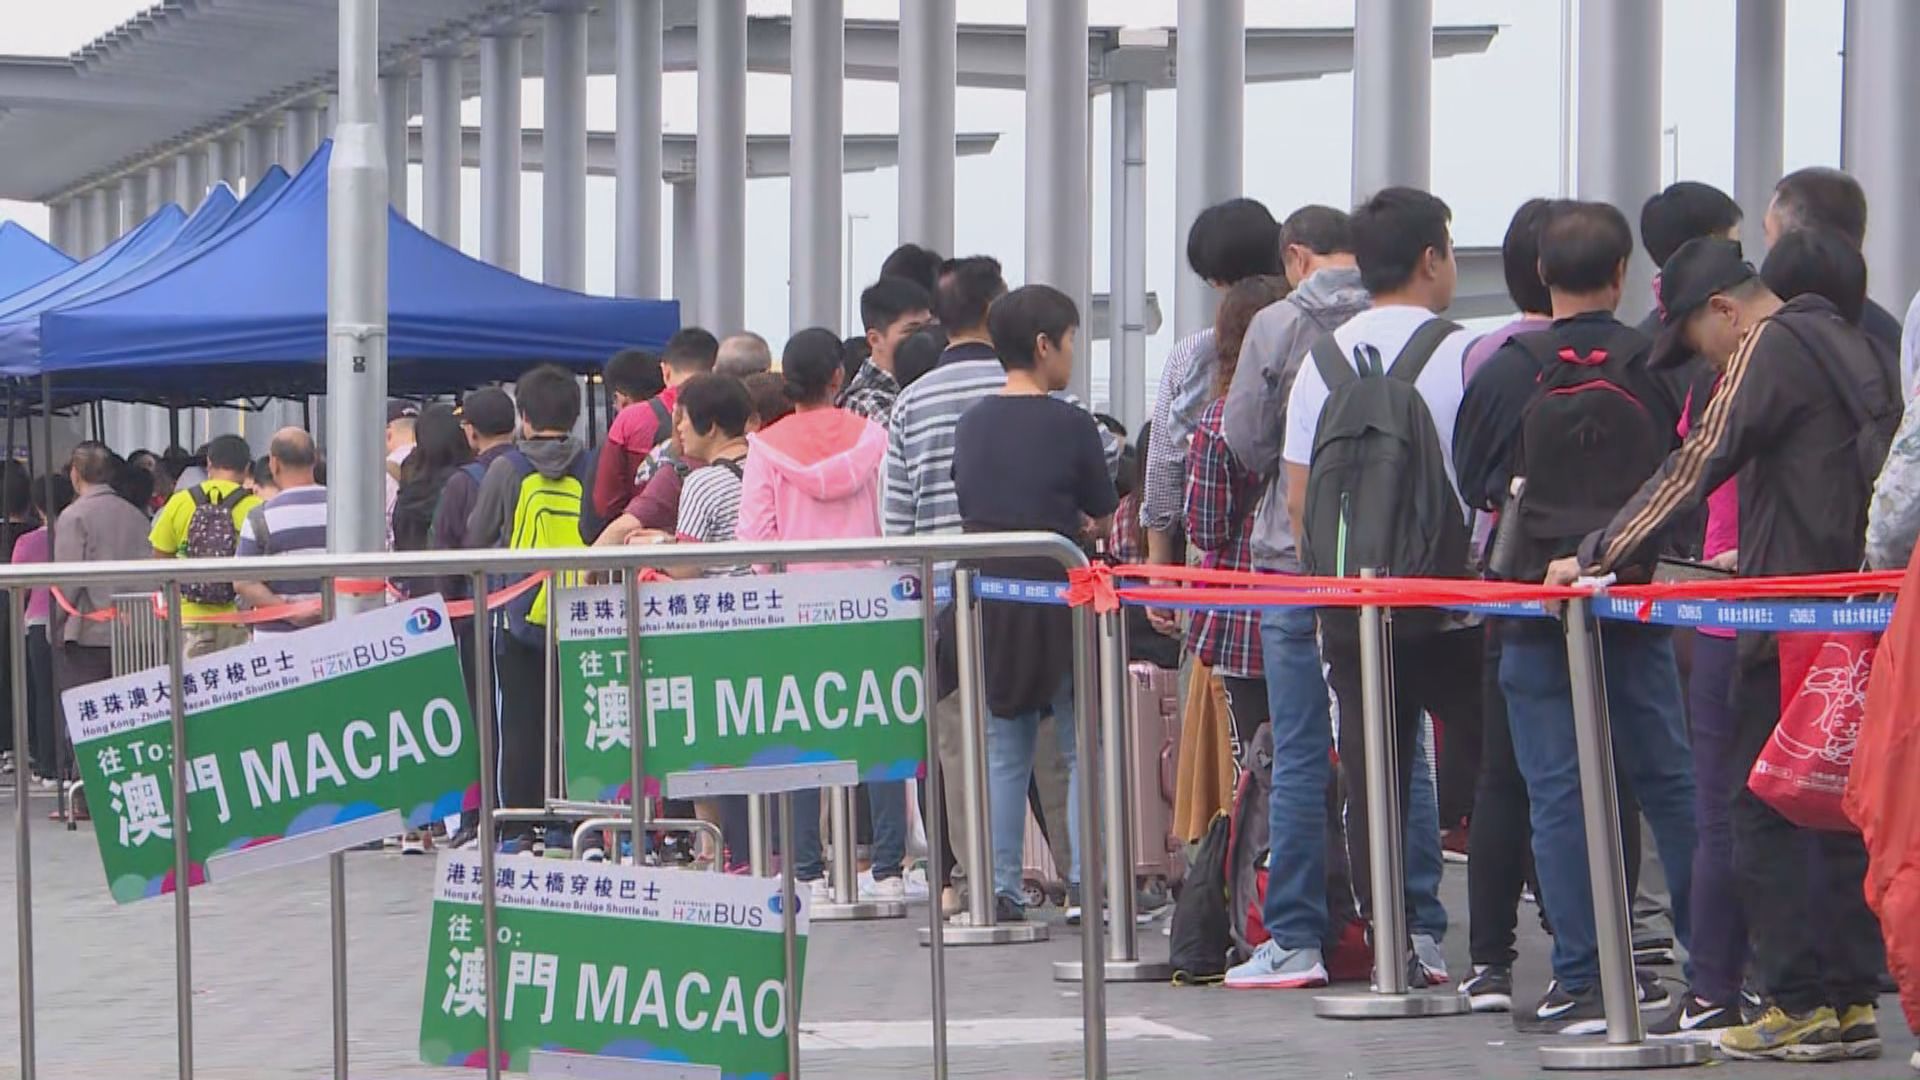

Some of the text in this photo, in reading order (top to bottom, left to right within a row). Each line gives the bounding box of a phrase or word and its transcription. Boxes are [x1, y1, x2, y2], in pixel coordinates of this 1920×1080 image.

[570, 589, 784, 621] 港珠大橋穿梭巴士
[570, 614, 785, 638] Hong Kong-uhai-Macao Bridge Shuttle Bus
[579, 650, 653, 678] 往 T:
[83, 721, 109, 737] Hong
[212, 689, 243, 704] Bridge
[246, 680, 280, 696] Shuttle
[282, 674, 300, 687] Bus
[583, 665, 924, 752] 澳門 MACAO
[97, 746, 125, 777] 往
[109, 698, 462, 847] 澳門 MACAO
[444, 888, 469, 900] Hong
[573, 901, 603, 914] Bridge
[606, 903, 640, 916] Shuttle
[642, 906, 660, 917] Bus
[448, 914, 521, 946] 往 o:
[441, 946, 786, 1038] 澳門 MACAO
